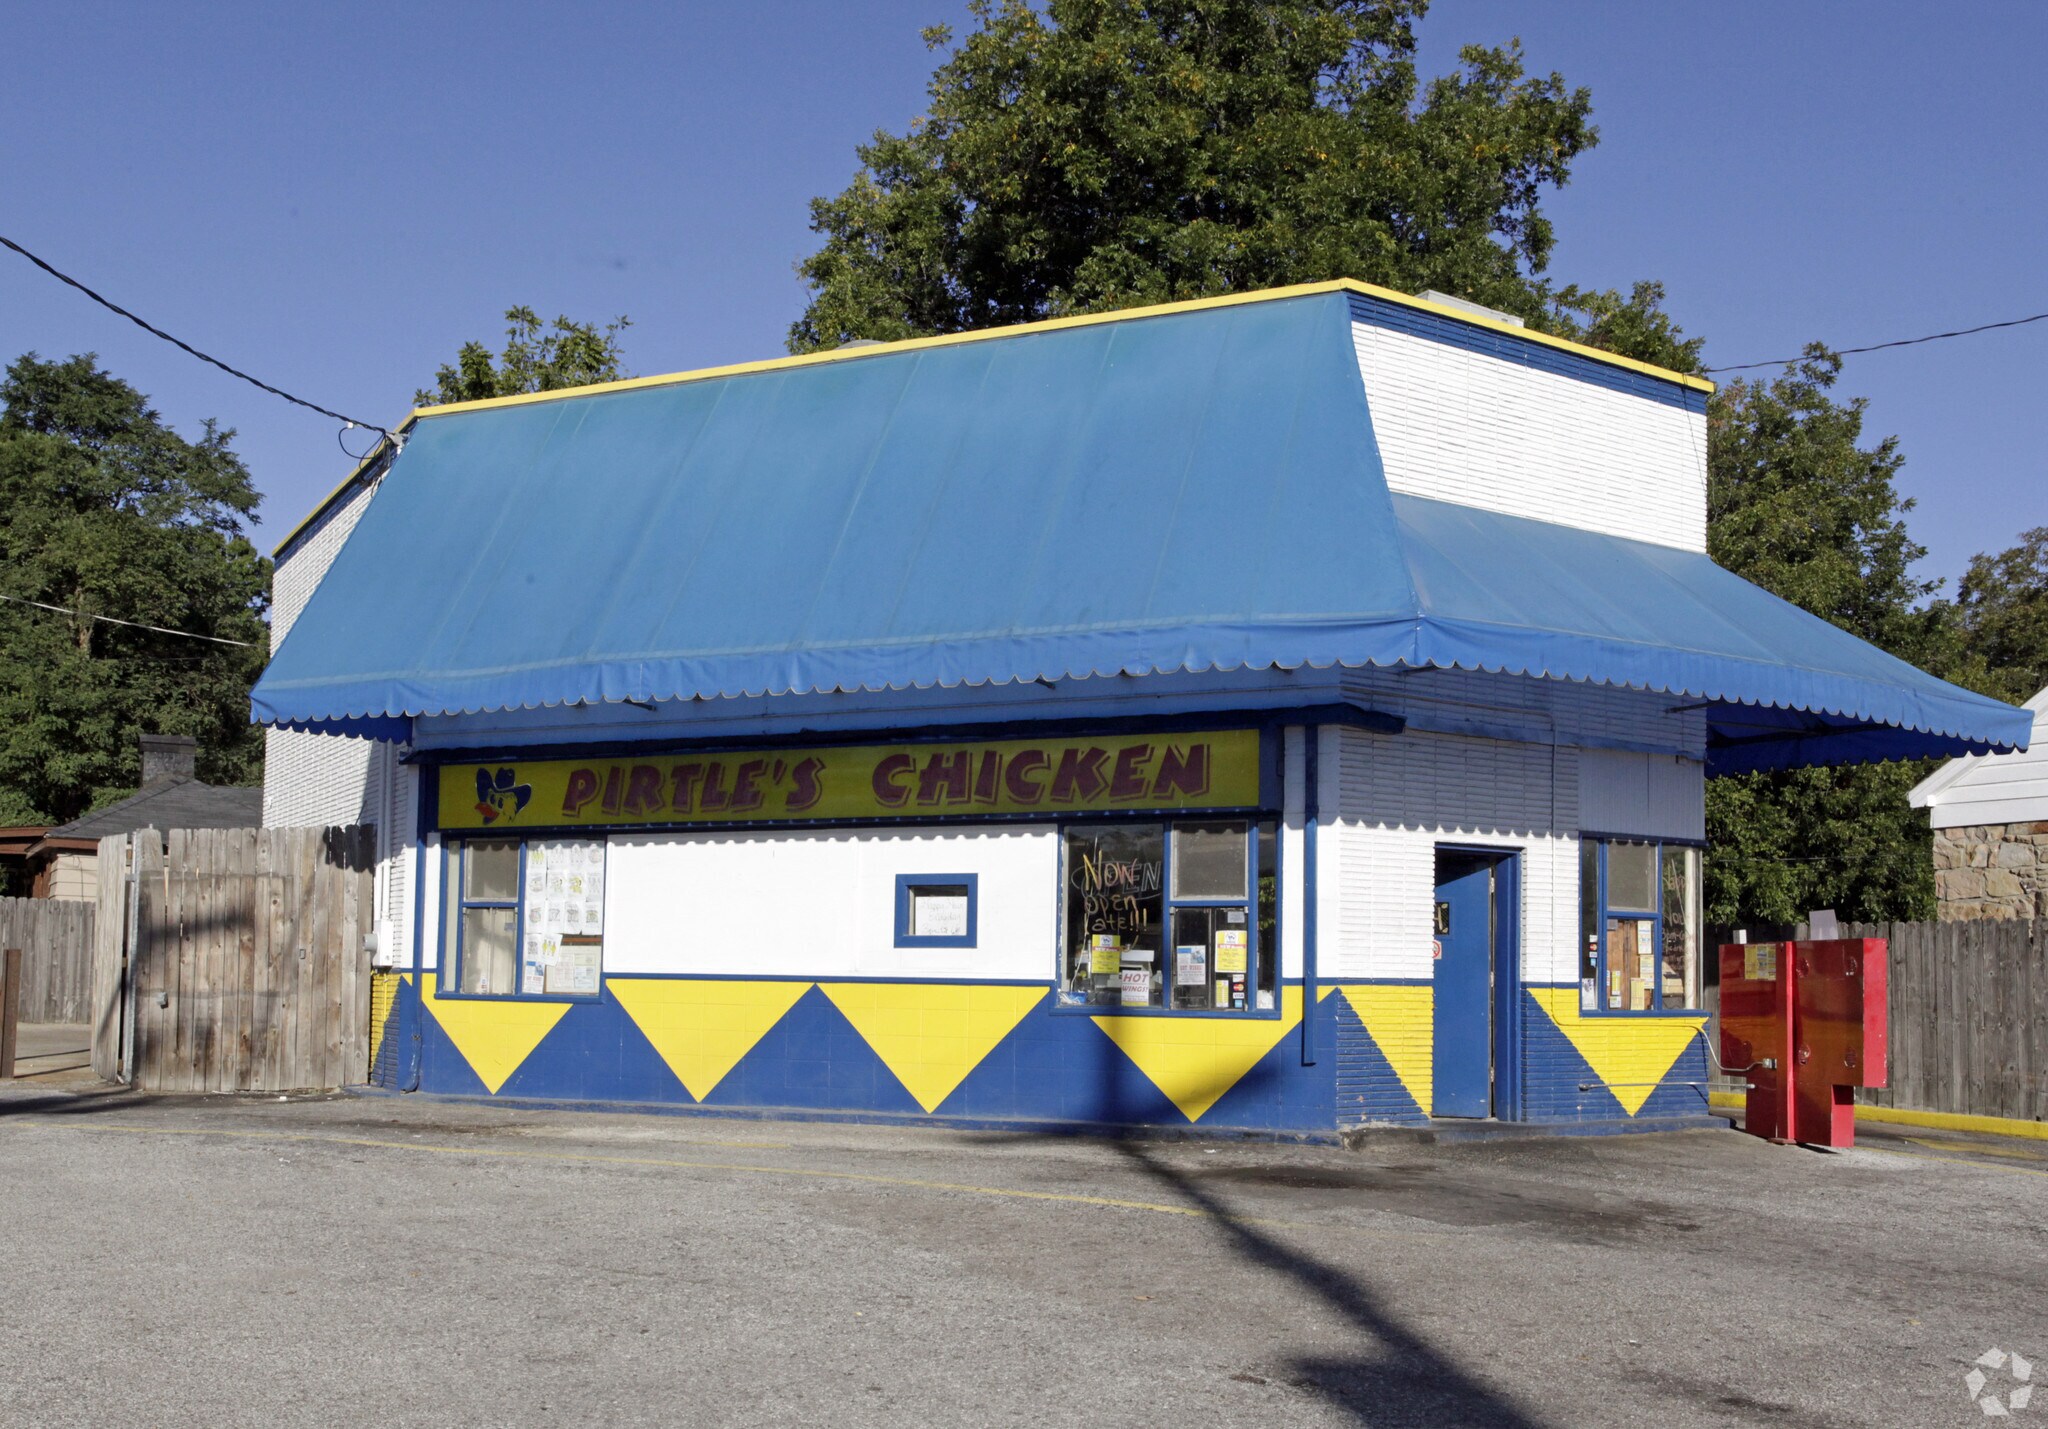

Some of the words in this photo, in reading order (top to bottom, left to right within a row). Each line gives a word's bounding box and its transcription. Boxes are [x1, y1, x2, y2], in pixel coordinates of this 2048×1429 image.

[562, 756, 827, 818] PIRTLE'S
[871, 743, 1211, 809] CHICKEN
[1123, 973, 1148, 983] HOT
